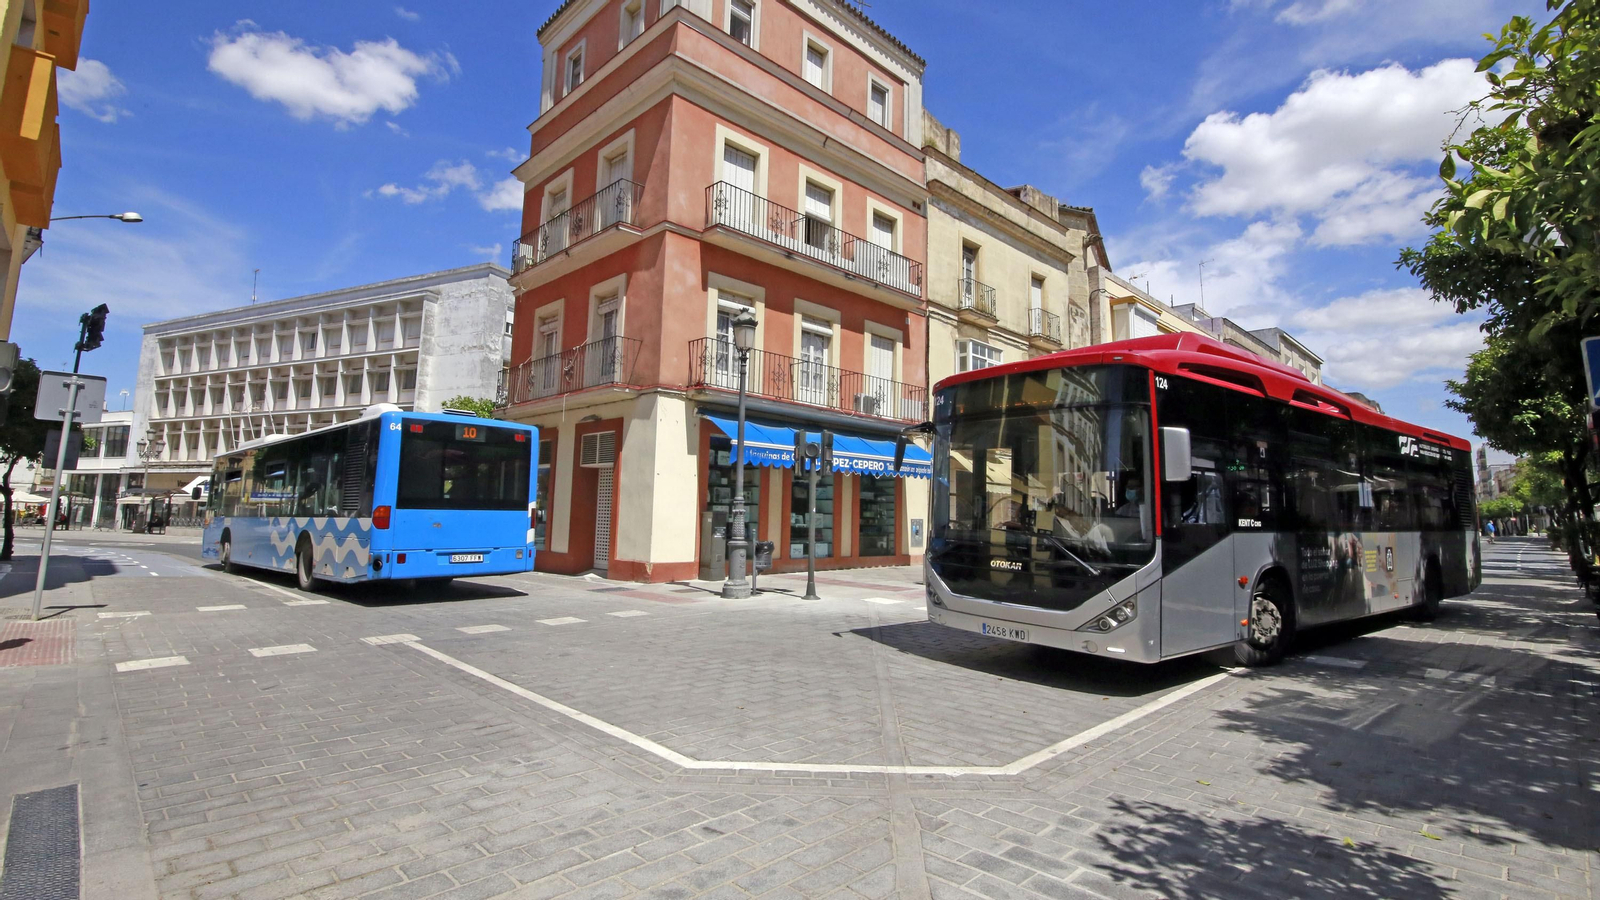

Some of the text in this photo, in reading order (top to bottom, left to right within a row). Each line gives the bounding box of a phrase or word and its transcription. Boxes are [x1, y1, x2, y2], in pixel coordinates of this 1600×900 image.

[1155, 376, 1168, 389] 124
[390, 422, 402, 431] 64
[462, 426, 477, 438] 10
[782, 452, 790, 461] de
[1238, 518, 1250, 527] KENT
[990, 561, 1022, 571] OTOKAR
[987, 625, 1026, 640] 2458 KWD
